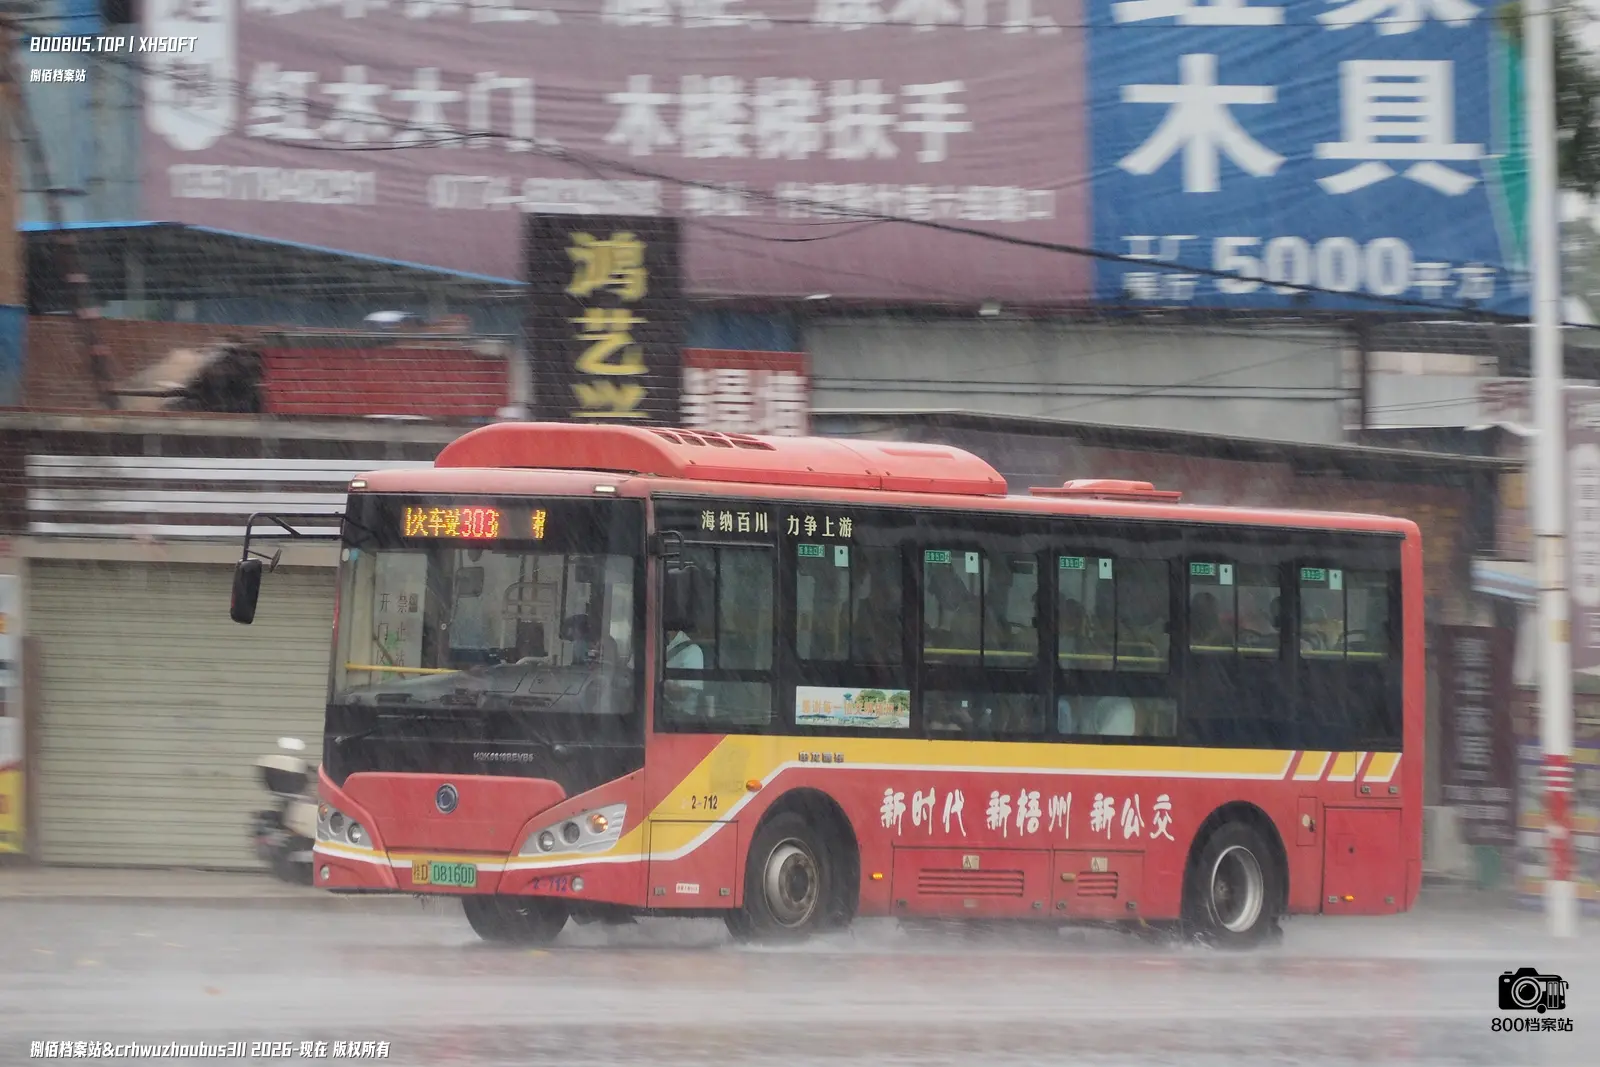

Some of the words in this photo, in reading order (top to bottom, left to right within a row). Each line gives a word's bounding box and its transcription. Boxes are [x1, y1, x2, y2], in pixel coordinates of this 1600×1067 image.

[701, 510, 768, 533] 海纳百川
[787, 515, 853, 538] 力争上游
[880, 788, 966, 837] 新时代
[986, 789, 1072, 840] 新梧州
[1090, 793, 1175, 841] 新公交
